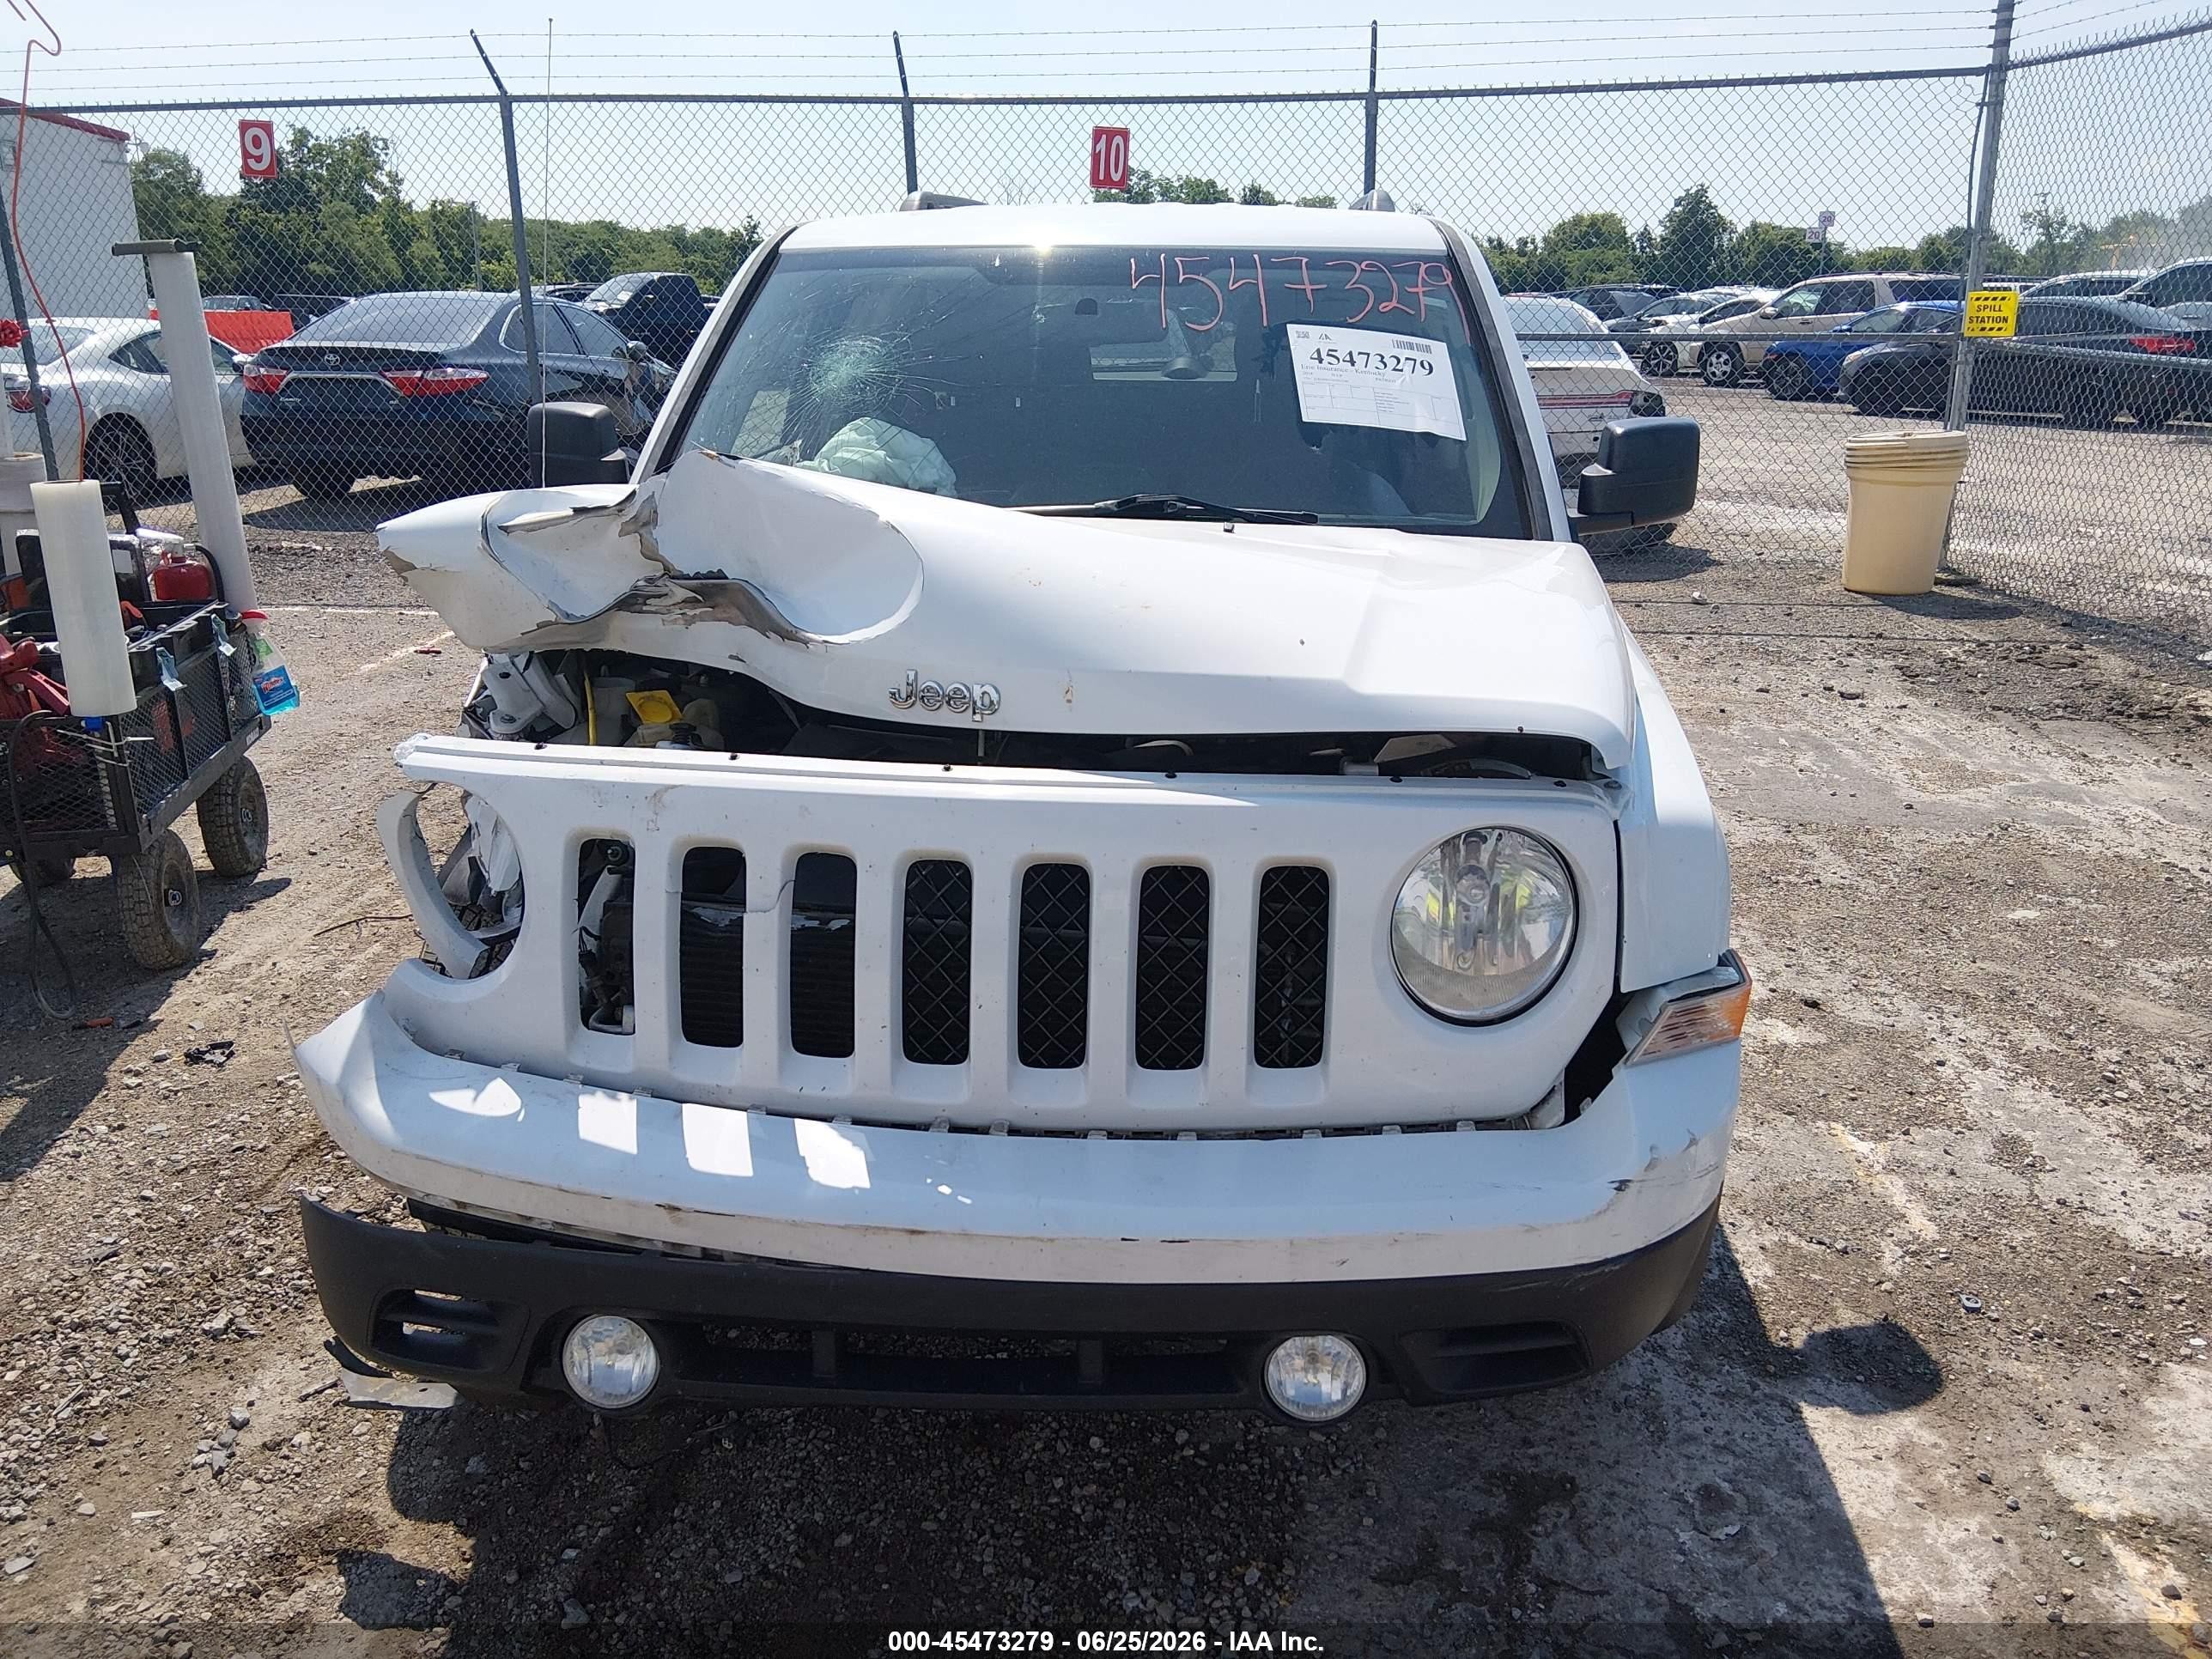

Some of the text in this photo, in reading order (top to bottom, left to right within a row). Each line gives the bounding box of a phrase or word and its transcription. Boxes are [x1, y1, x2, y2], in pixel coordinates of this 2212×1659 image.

[244, 126, 271, 171] 9
[1095, 134, 1125, 182] 10
[1808, 231, 1820, 240] 20
[1130, 253, 1471, 347] 45473279
[1976, 304, 2003, 313] SPILL
[1968, 315, 2008, 325] STATION
[1310, 347, 1434, 376] 45473279
[888, 668, 1001, 722] Jeep
